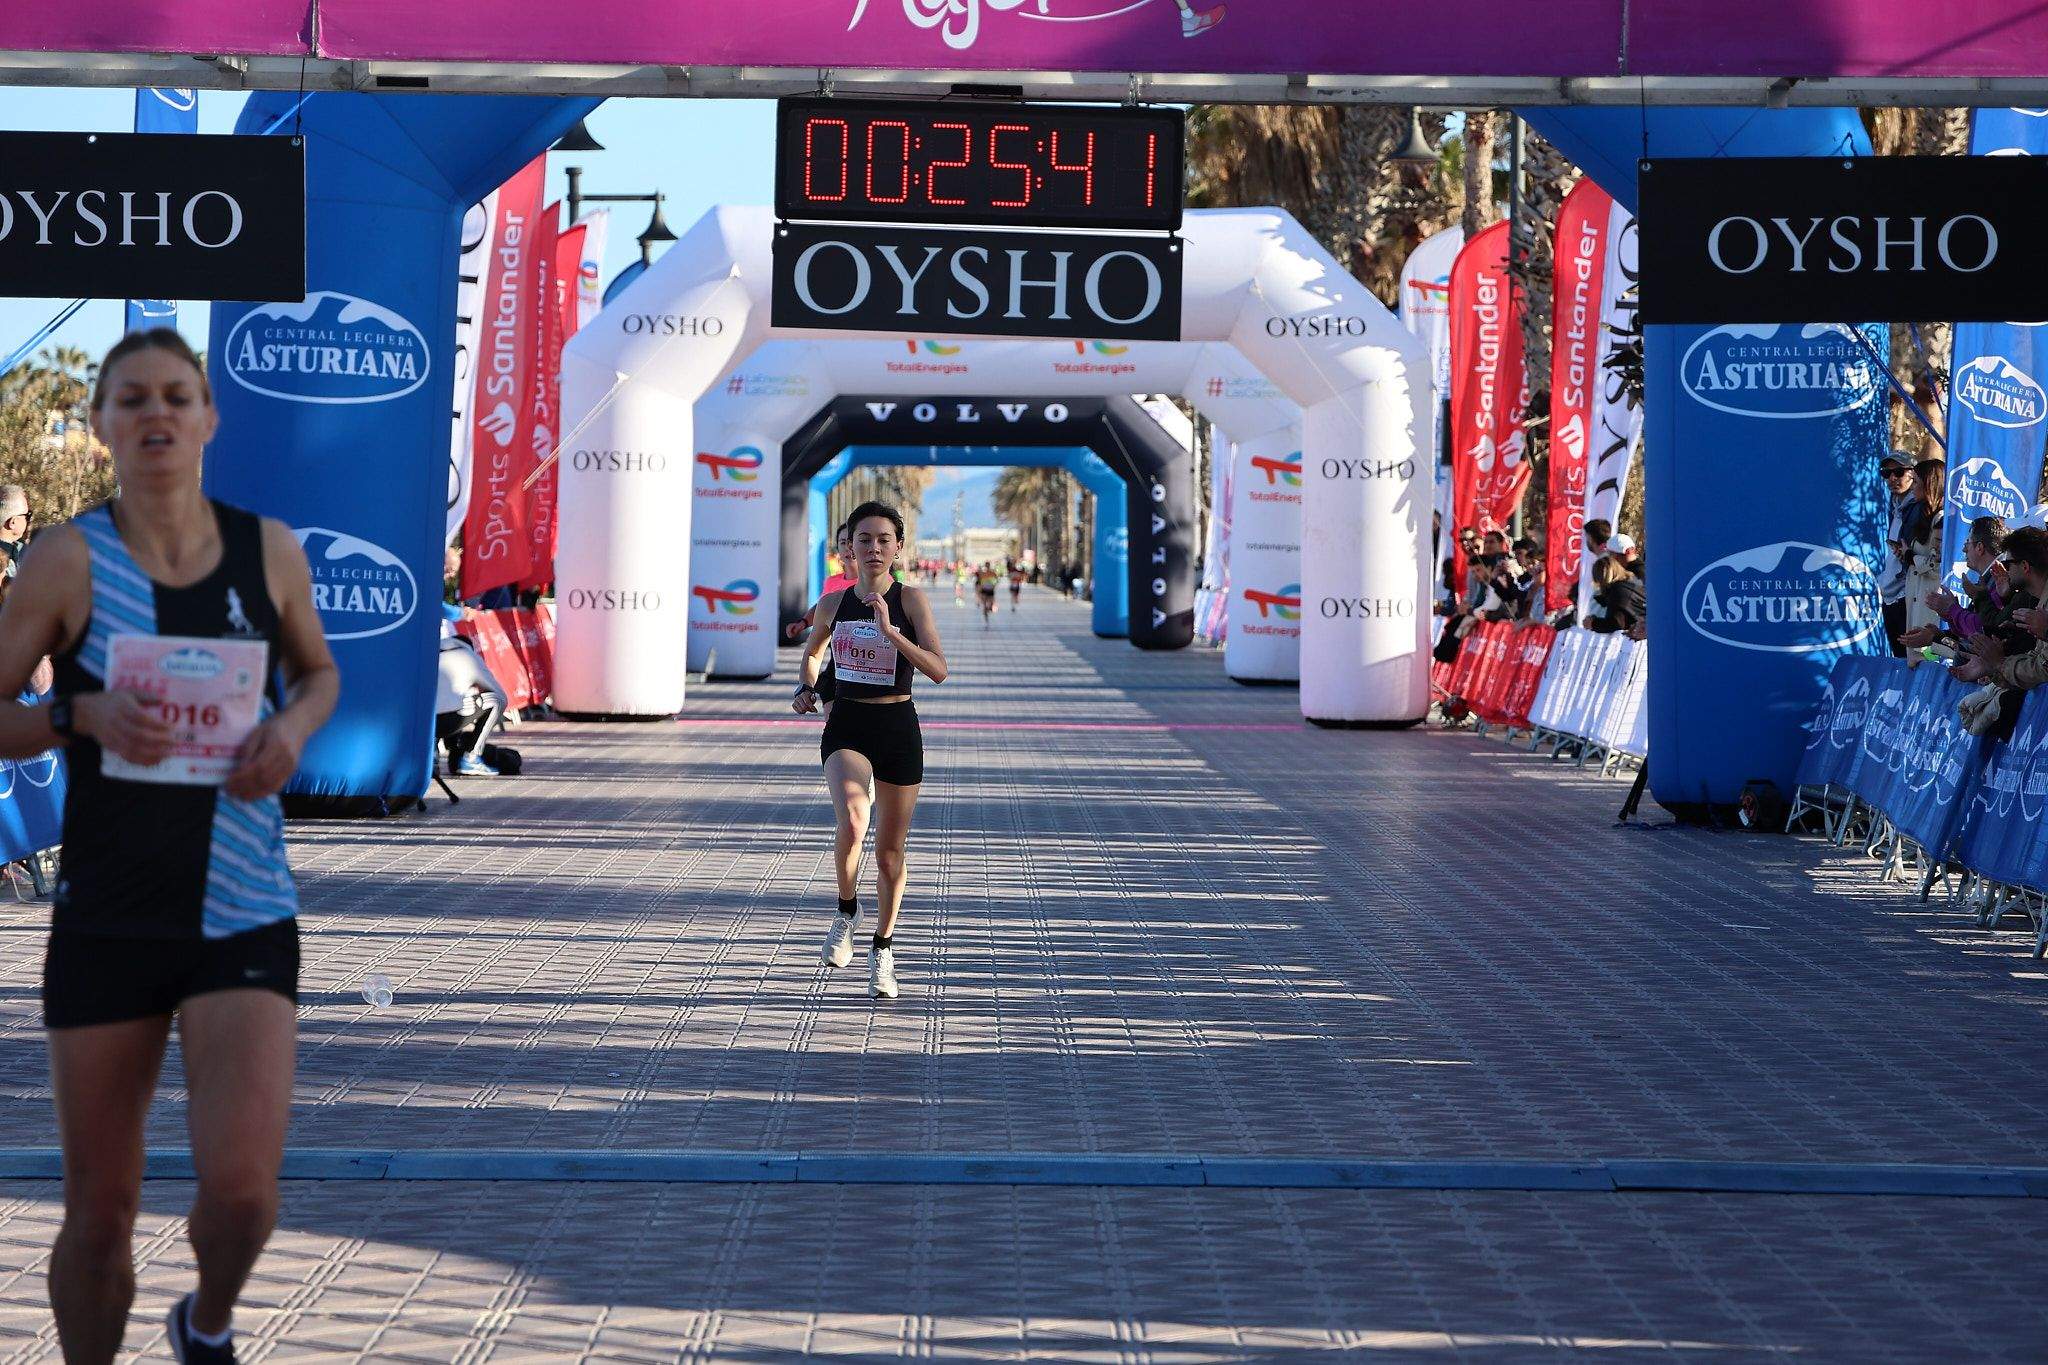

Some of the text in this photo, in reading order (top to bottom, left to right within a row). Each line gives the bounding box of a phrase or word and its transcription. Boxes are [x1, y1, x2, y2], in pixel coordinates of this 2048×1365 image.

[0, 190, 243, 248] YSHO
[1707, 214, 1999, 274] OYSHO
[793, 240, 1163, 325] OYSHO
[1563, 219, 1599, 408] Santander
[622, 313, 724, 337] OYSHO
[1266, 316, 1366, 338] OYSHO
[264, 328, 414, 348] CENTRAL LECHERA
[234, 329, 418, 381] ASTURIANA
[1475, 271, 1500, 430] Santander
[1727, 347, 1800, 357] CENTRAL
[886, 361, 968, 374] TotalEnergies
[1053, 362, 1136, 376] TotalEnergies
[477, 209, 526, 560] Sports Santander
[865, 402, 1069, 423] VOLVO
[573, 450, 666, 473] OYSHO
[1321, 458, 1415, 480] OYSHO
[695, 487, 763, 500] TotalEnergies
[1249, 491, 1302, 504] TotalEnerg
[1151, 483, 1167, 630] VOLVO
[331, 567, 401, 582] LECHERA
[1729, 580, 1802, 590] CENTRAL
[310, 583, 405, 615] RIANA
[568, 588, 661, 611] OYSHO
[1321, 597, 1413, 619] OYSHO
[689, 622, 760, 635] TotalEnergies
[851, 648, 876, 660] 016
[162, 703, 220, 727] 016
